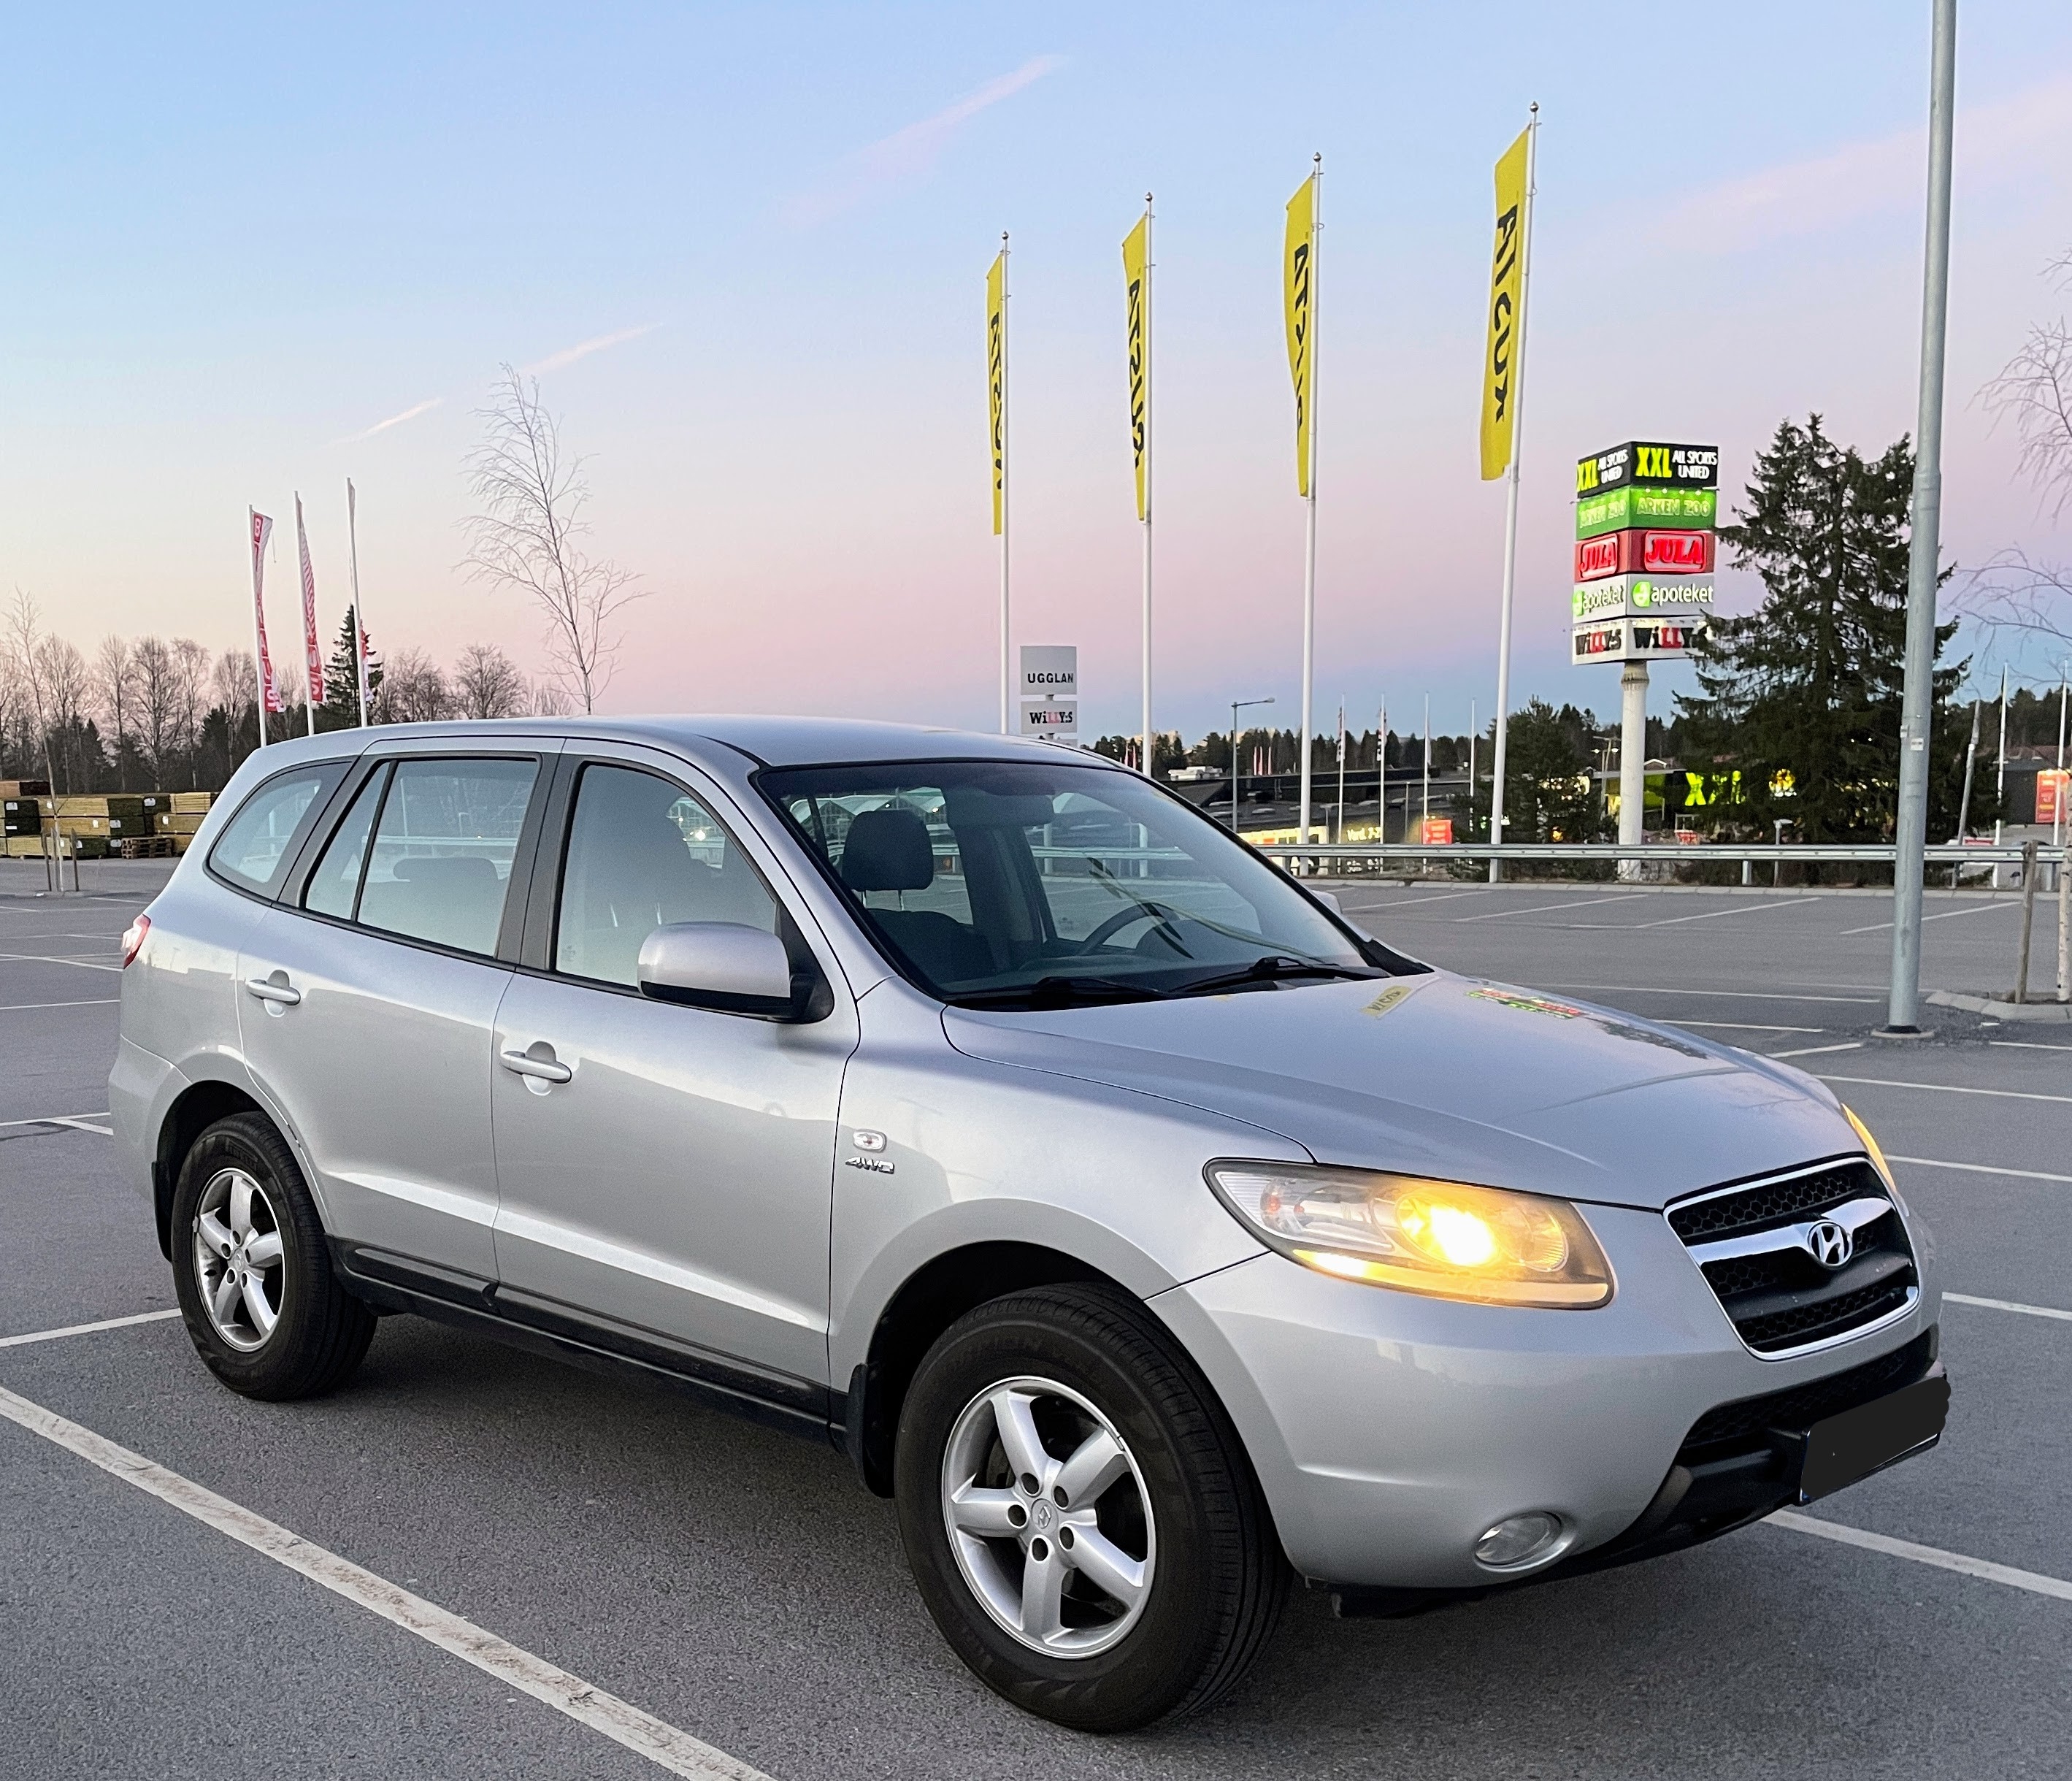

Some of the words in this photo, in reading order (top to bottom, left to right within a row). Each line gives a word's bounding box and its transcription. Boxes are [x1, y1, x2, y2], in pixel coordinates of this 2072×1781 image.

[1635, 447, 1673, 478] XXL
[1672, 450, 1686, 464] ALL
[1687, 451, 1718, 465] SPORTS
[1576, 459, 1598, 492] XXL
[1678, 465, 1710, 480] UNITED
[1636, 497, 1680, 516] ARKEN
[1684, 500, 1711, 517] ZOO
[1580, 542, 1616, 572] JULA
[1646, 537, 1703, 564] JULA
[1583, 586, 1624, 613] apoteket
[1651, 583, 1714, 607] apoteket
[1027, 673, 1074, 683] UGGLAN
[845, 1157, 895, 1175] 4WD
